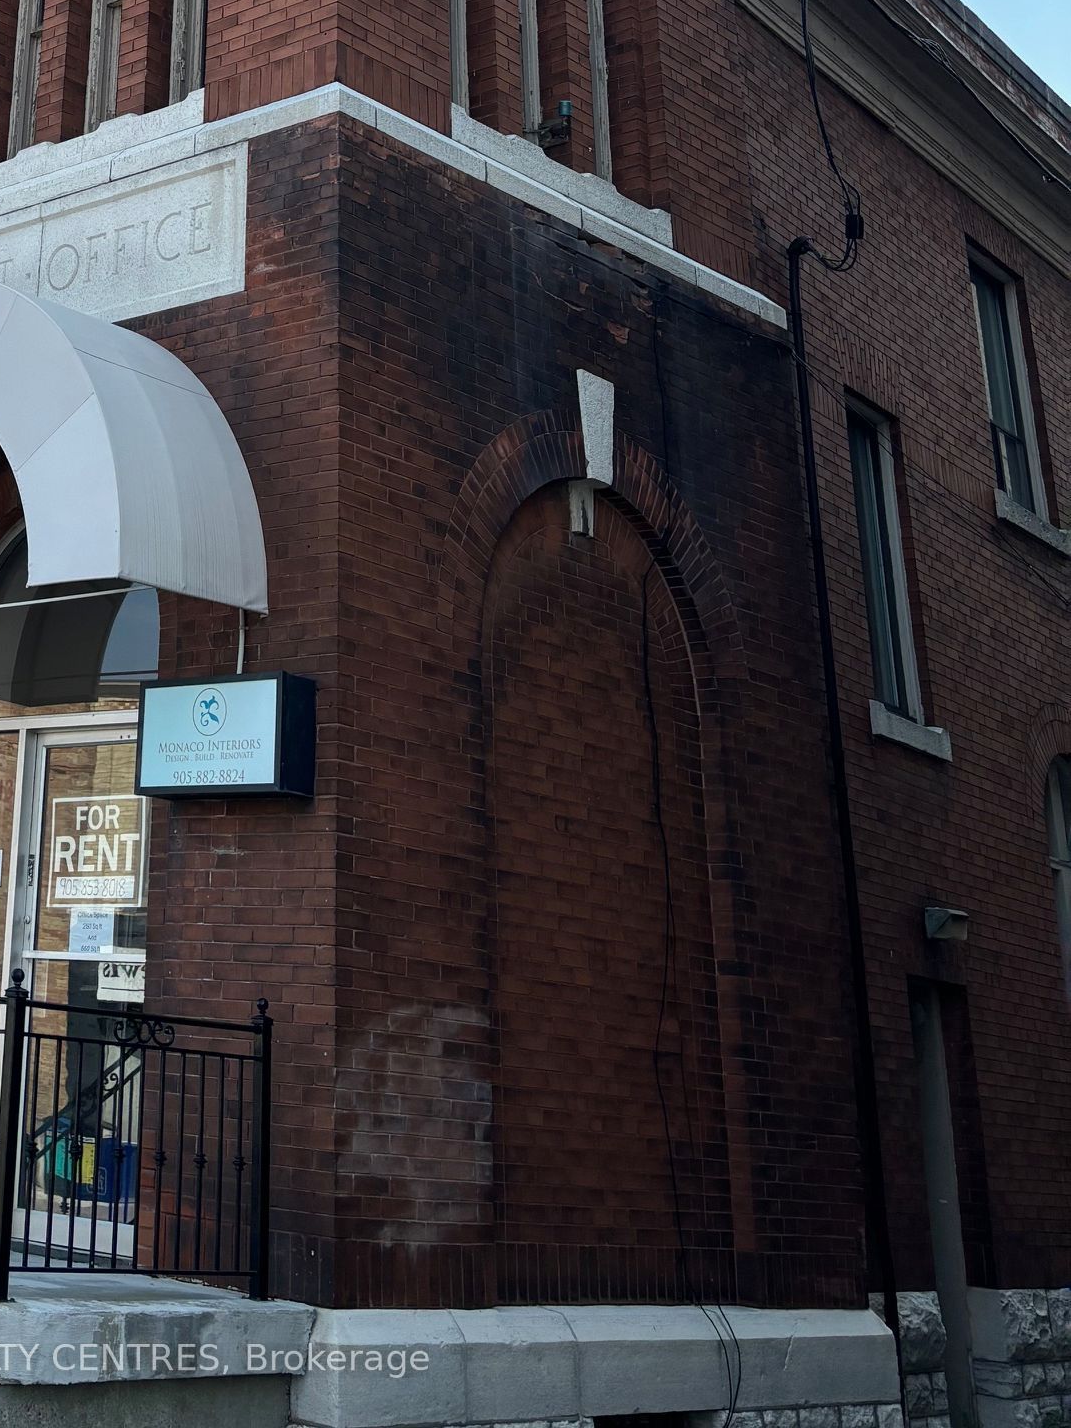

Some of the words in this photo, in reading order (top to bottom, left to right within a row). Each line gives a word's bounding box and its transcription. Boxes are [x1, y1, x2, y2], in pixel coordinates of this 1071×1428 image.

[47, 202, 213, 291] OFFICE
[158, 741, 205, 754] MONACO
[209, 739, 262, 751] INTERIORS
[165, 754, 189, 763] DESIGN
[195, 753, 215, 761] BUILD
[220, 752, 254, 760] RENOVATE
[173, 769, 246, 784] 905-882-8824
[76, 804, 120, 830] FOR
[54, 833, 140, 872] RENT
